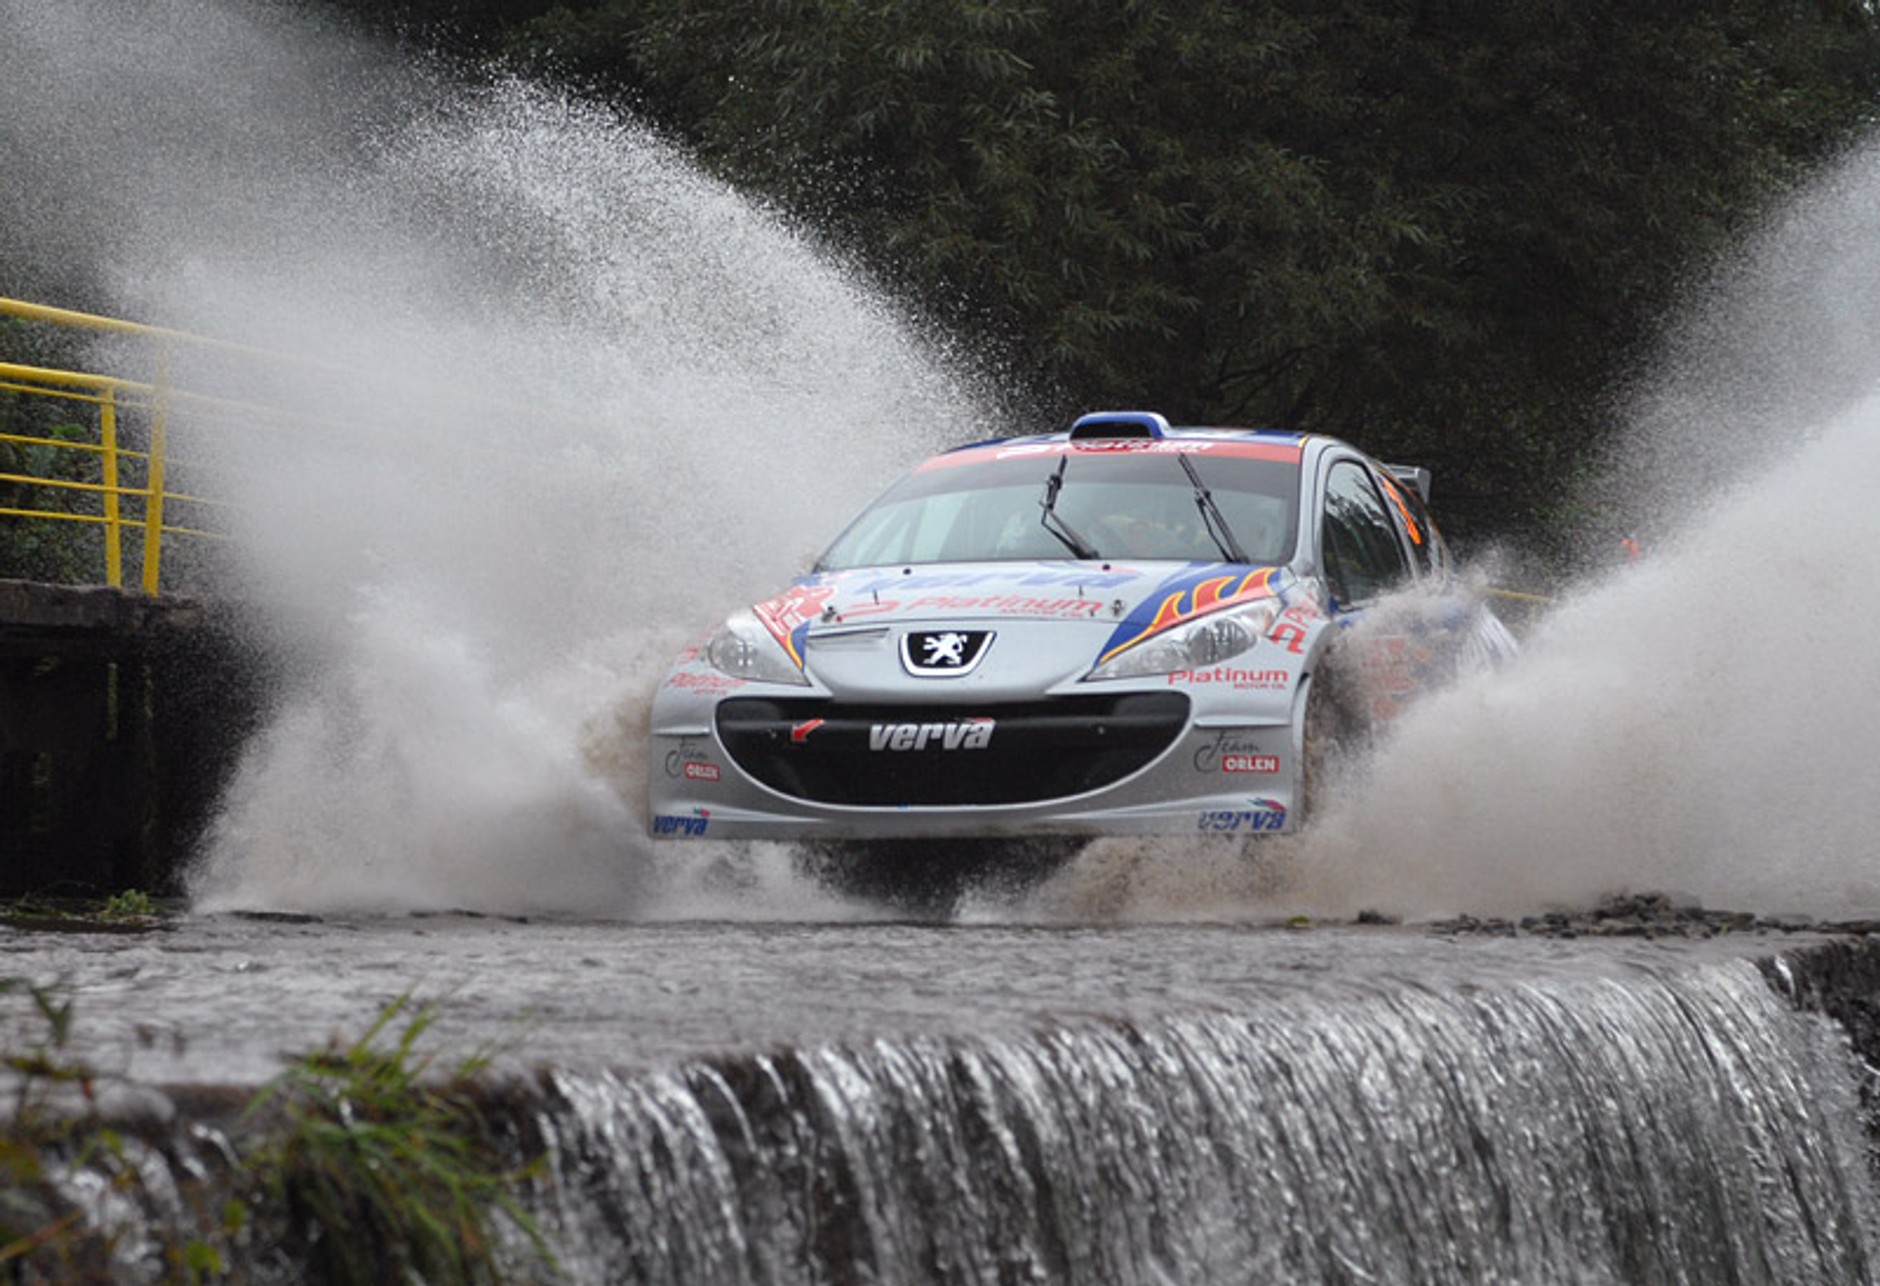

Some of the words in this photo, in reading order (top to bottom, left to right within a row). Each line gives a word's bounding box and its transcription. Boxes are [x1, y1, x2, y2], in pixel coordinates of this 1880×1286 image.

[1168, 668, 1289, 686] Platinum
[869, 720, 995, 751] verva
[1226, 755, 1276, 770] ORLEN
[653, 815, 709, 836] verva
